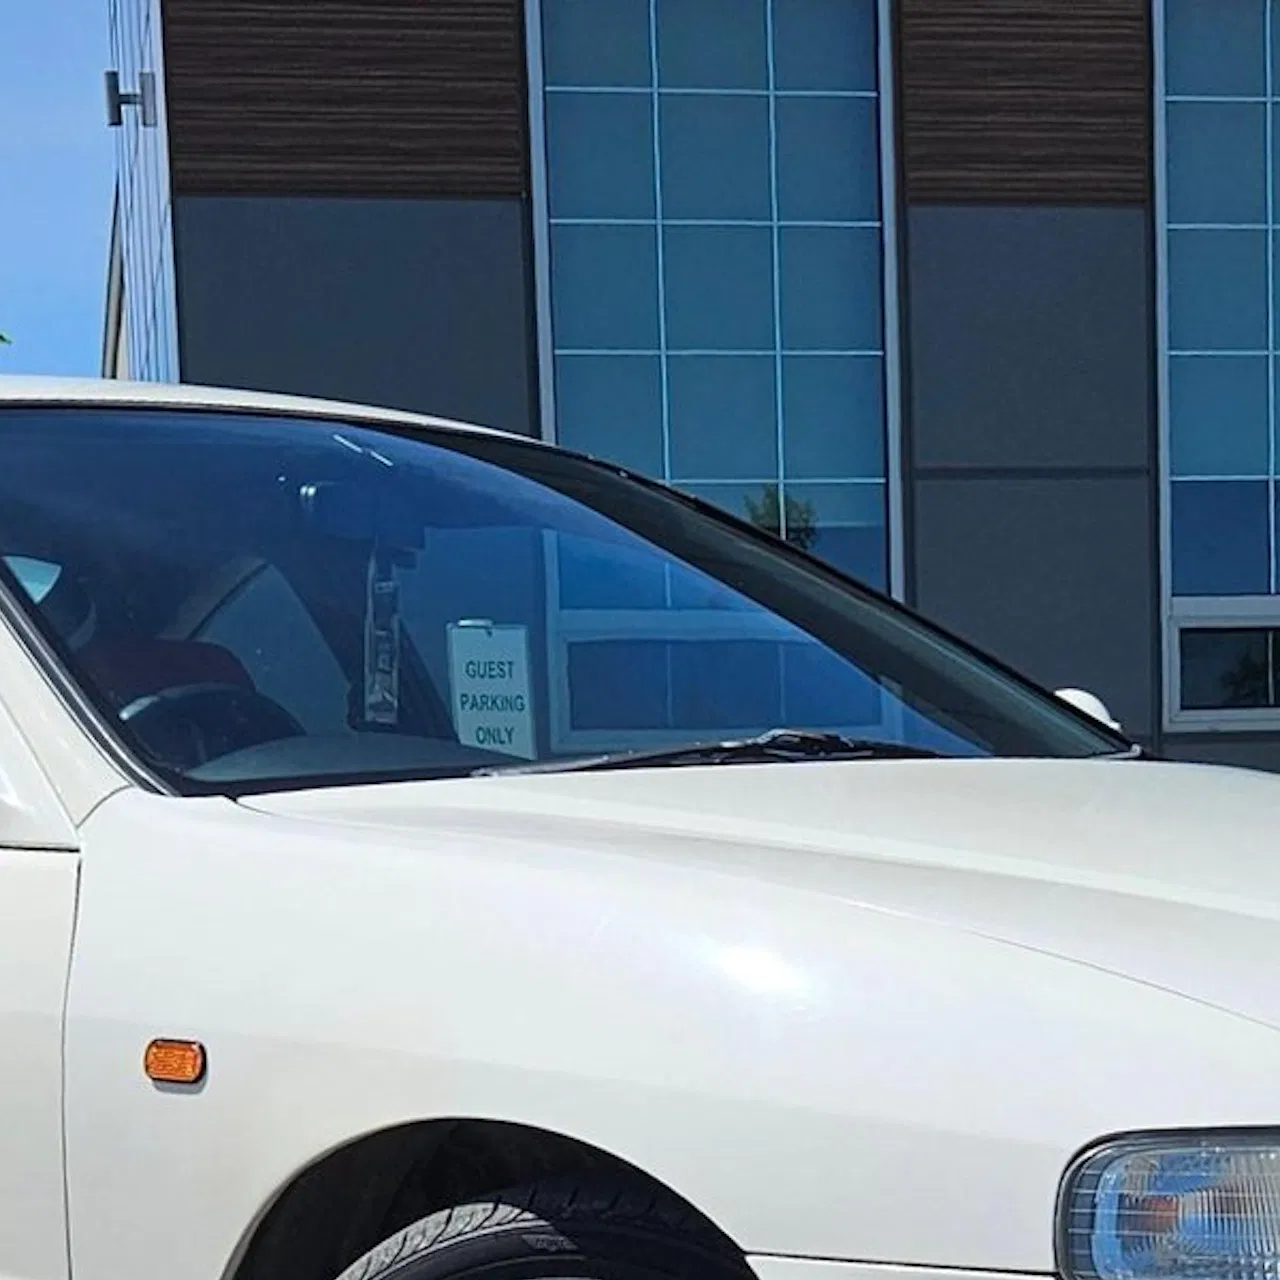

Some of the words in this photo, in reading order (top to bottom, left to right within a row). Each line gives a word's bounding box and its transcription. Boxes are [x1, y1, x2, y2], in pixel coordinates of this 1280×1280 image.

[465, 661, 514, 679] GUEST
[460, 693, 525, 712] PARKING
[475, 727, 515, 745] ONLY
